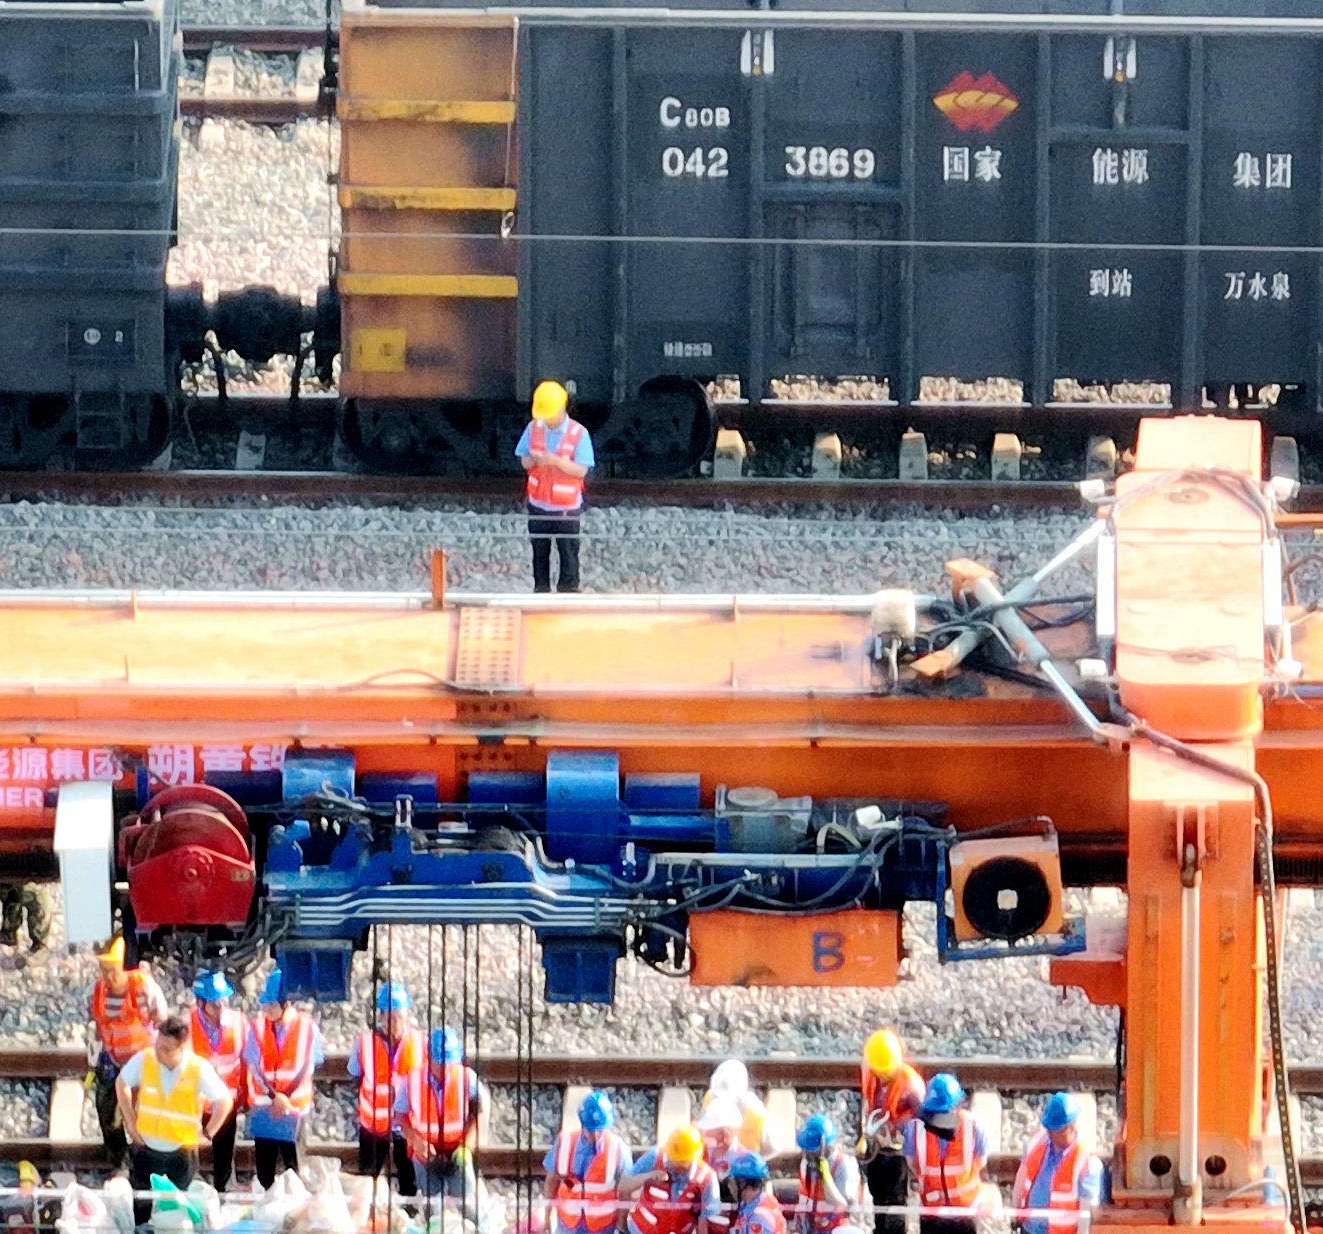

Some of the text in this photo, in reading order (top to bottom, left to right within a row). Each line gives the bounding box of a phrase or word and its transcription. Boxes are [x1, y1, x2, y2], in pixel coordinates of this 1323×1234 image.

[659, 96, 731, 128] C80B
[662, 146, 875, 178] 042 3869
[943, 145, 1292, 189] 国家 能源 集团
[1089, 268, 1291, 301] 到站 万水泉
[812, 931, 846, 973] B
